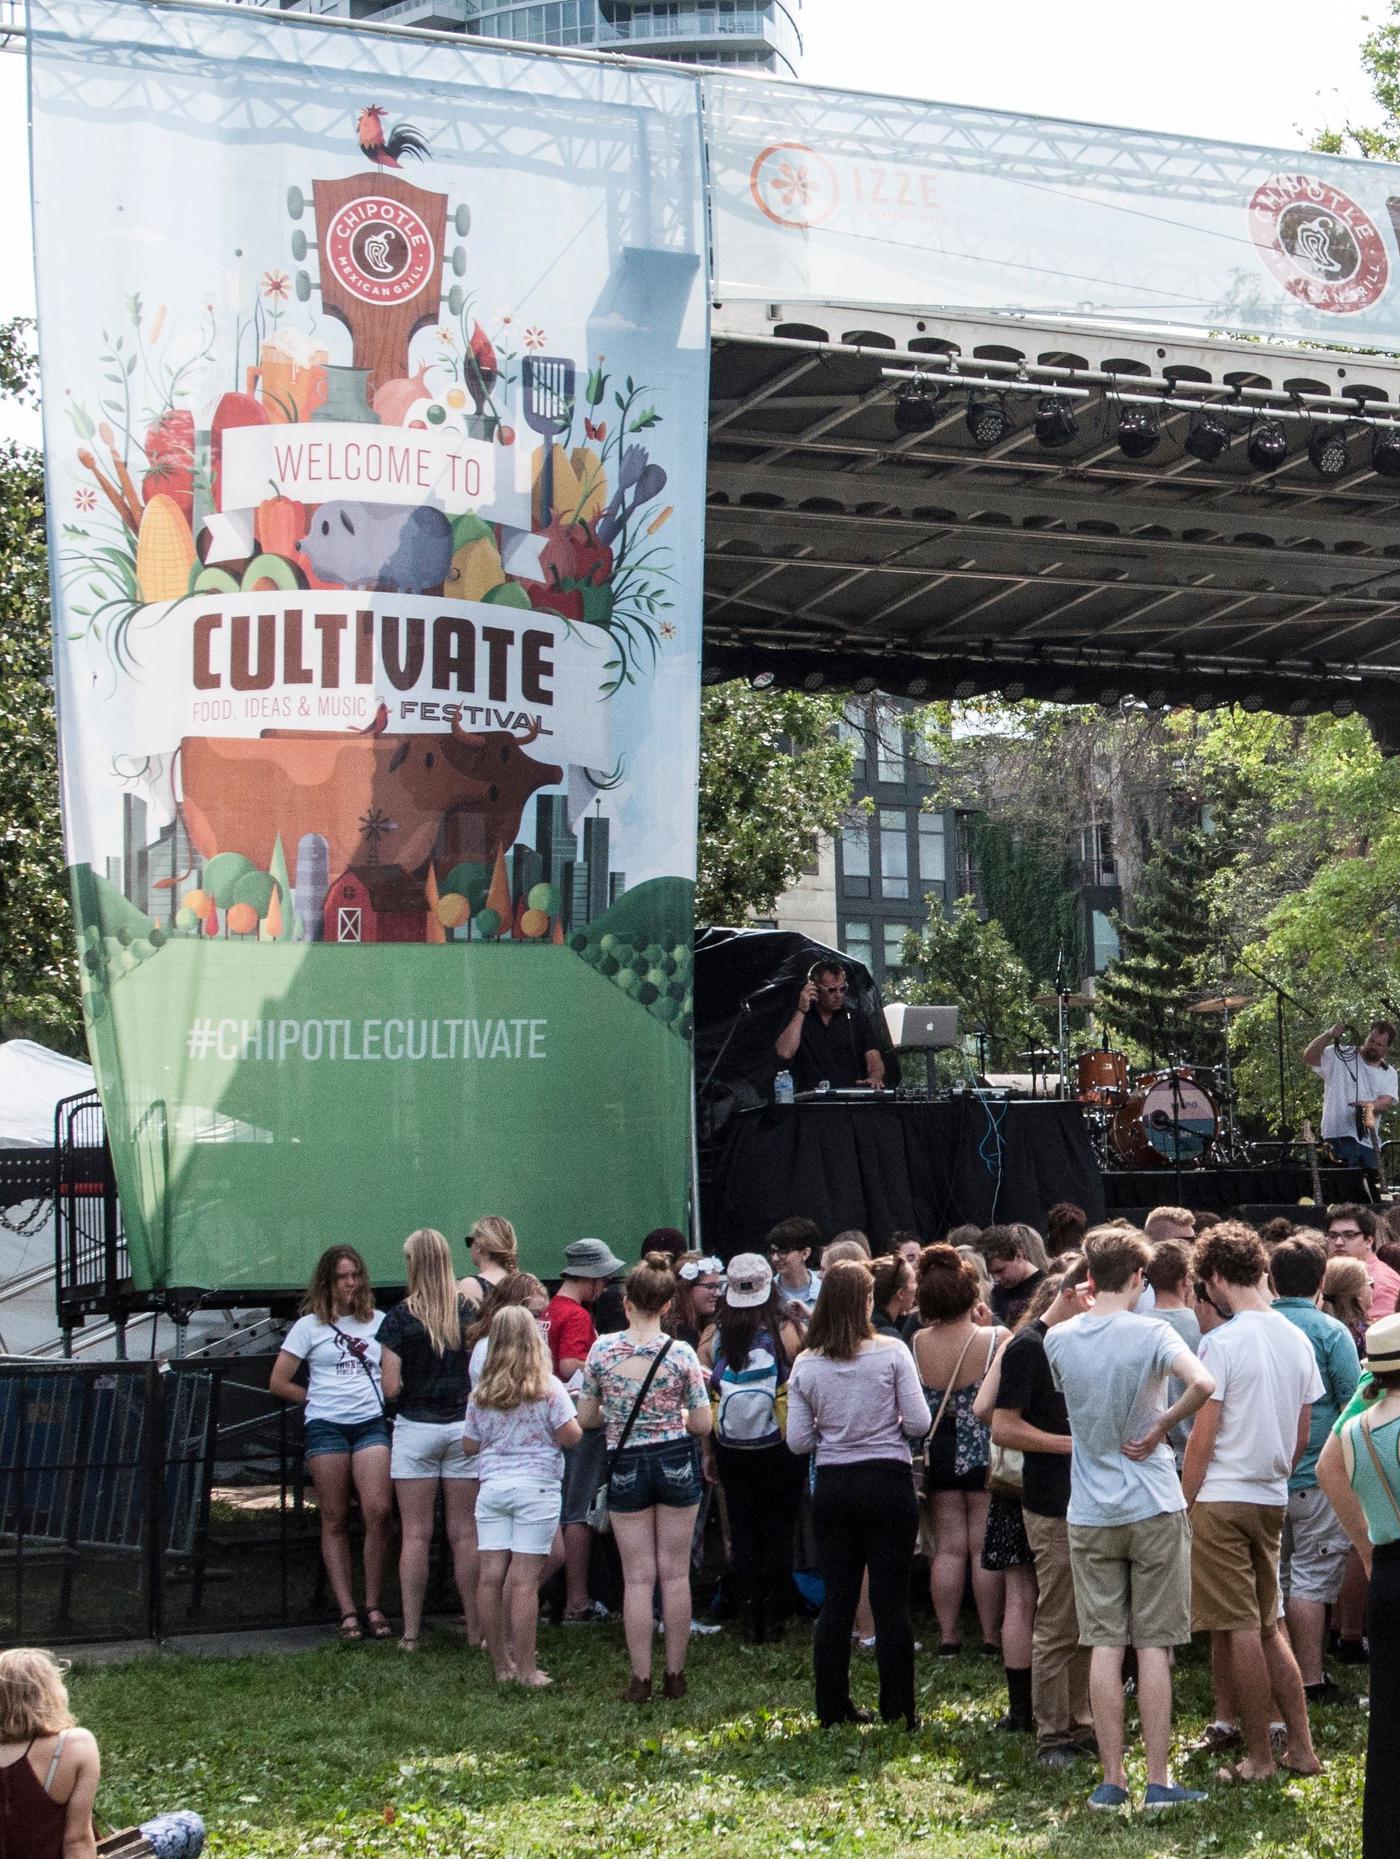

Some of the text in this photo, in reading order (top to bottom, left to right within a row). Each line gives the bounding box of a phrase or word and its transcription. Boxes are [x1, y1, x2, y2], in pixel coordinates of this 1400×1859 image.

[852, 167, 944, 209] IZZE
[336, 203, 426, 247] CHIPOTLE
[338, 256, 424, 296] MEXICAN GRILL
[275, 443, 480, 496] WELCOME TO
[193, 609, 554, 706] CULTIVATE
[245, 696, 291, 718] IDEAS
[299, 696, 311, 717] &
[317, 695, 367, 717] MUSIC
[400, 701, 554, 736] FESTIVAL
[186, 1018, 547, 1061] #CHIPOTLECULTIVATE
